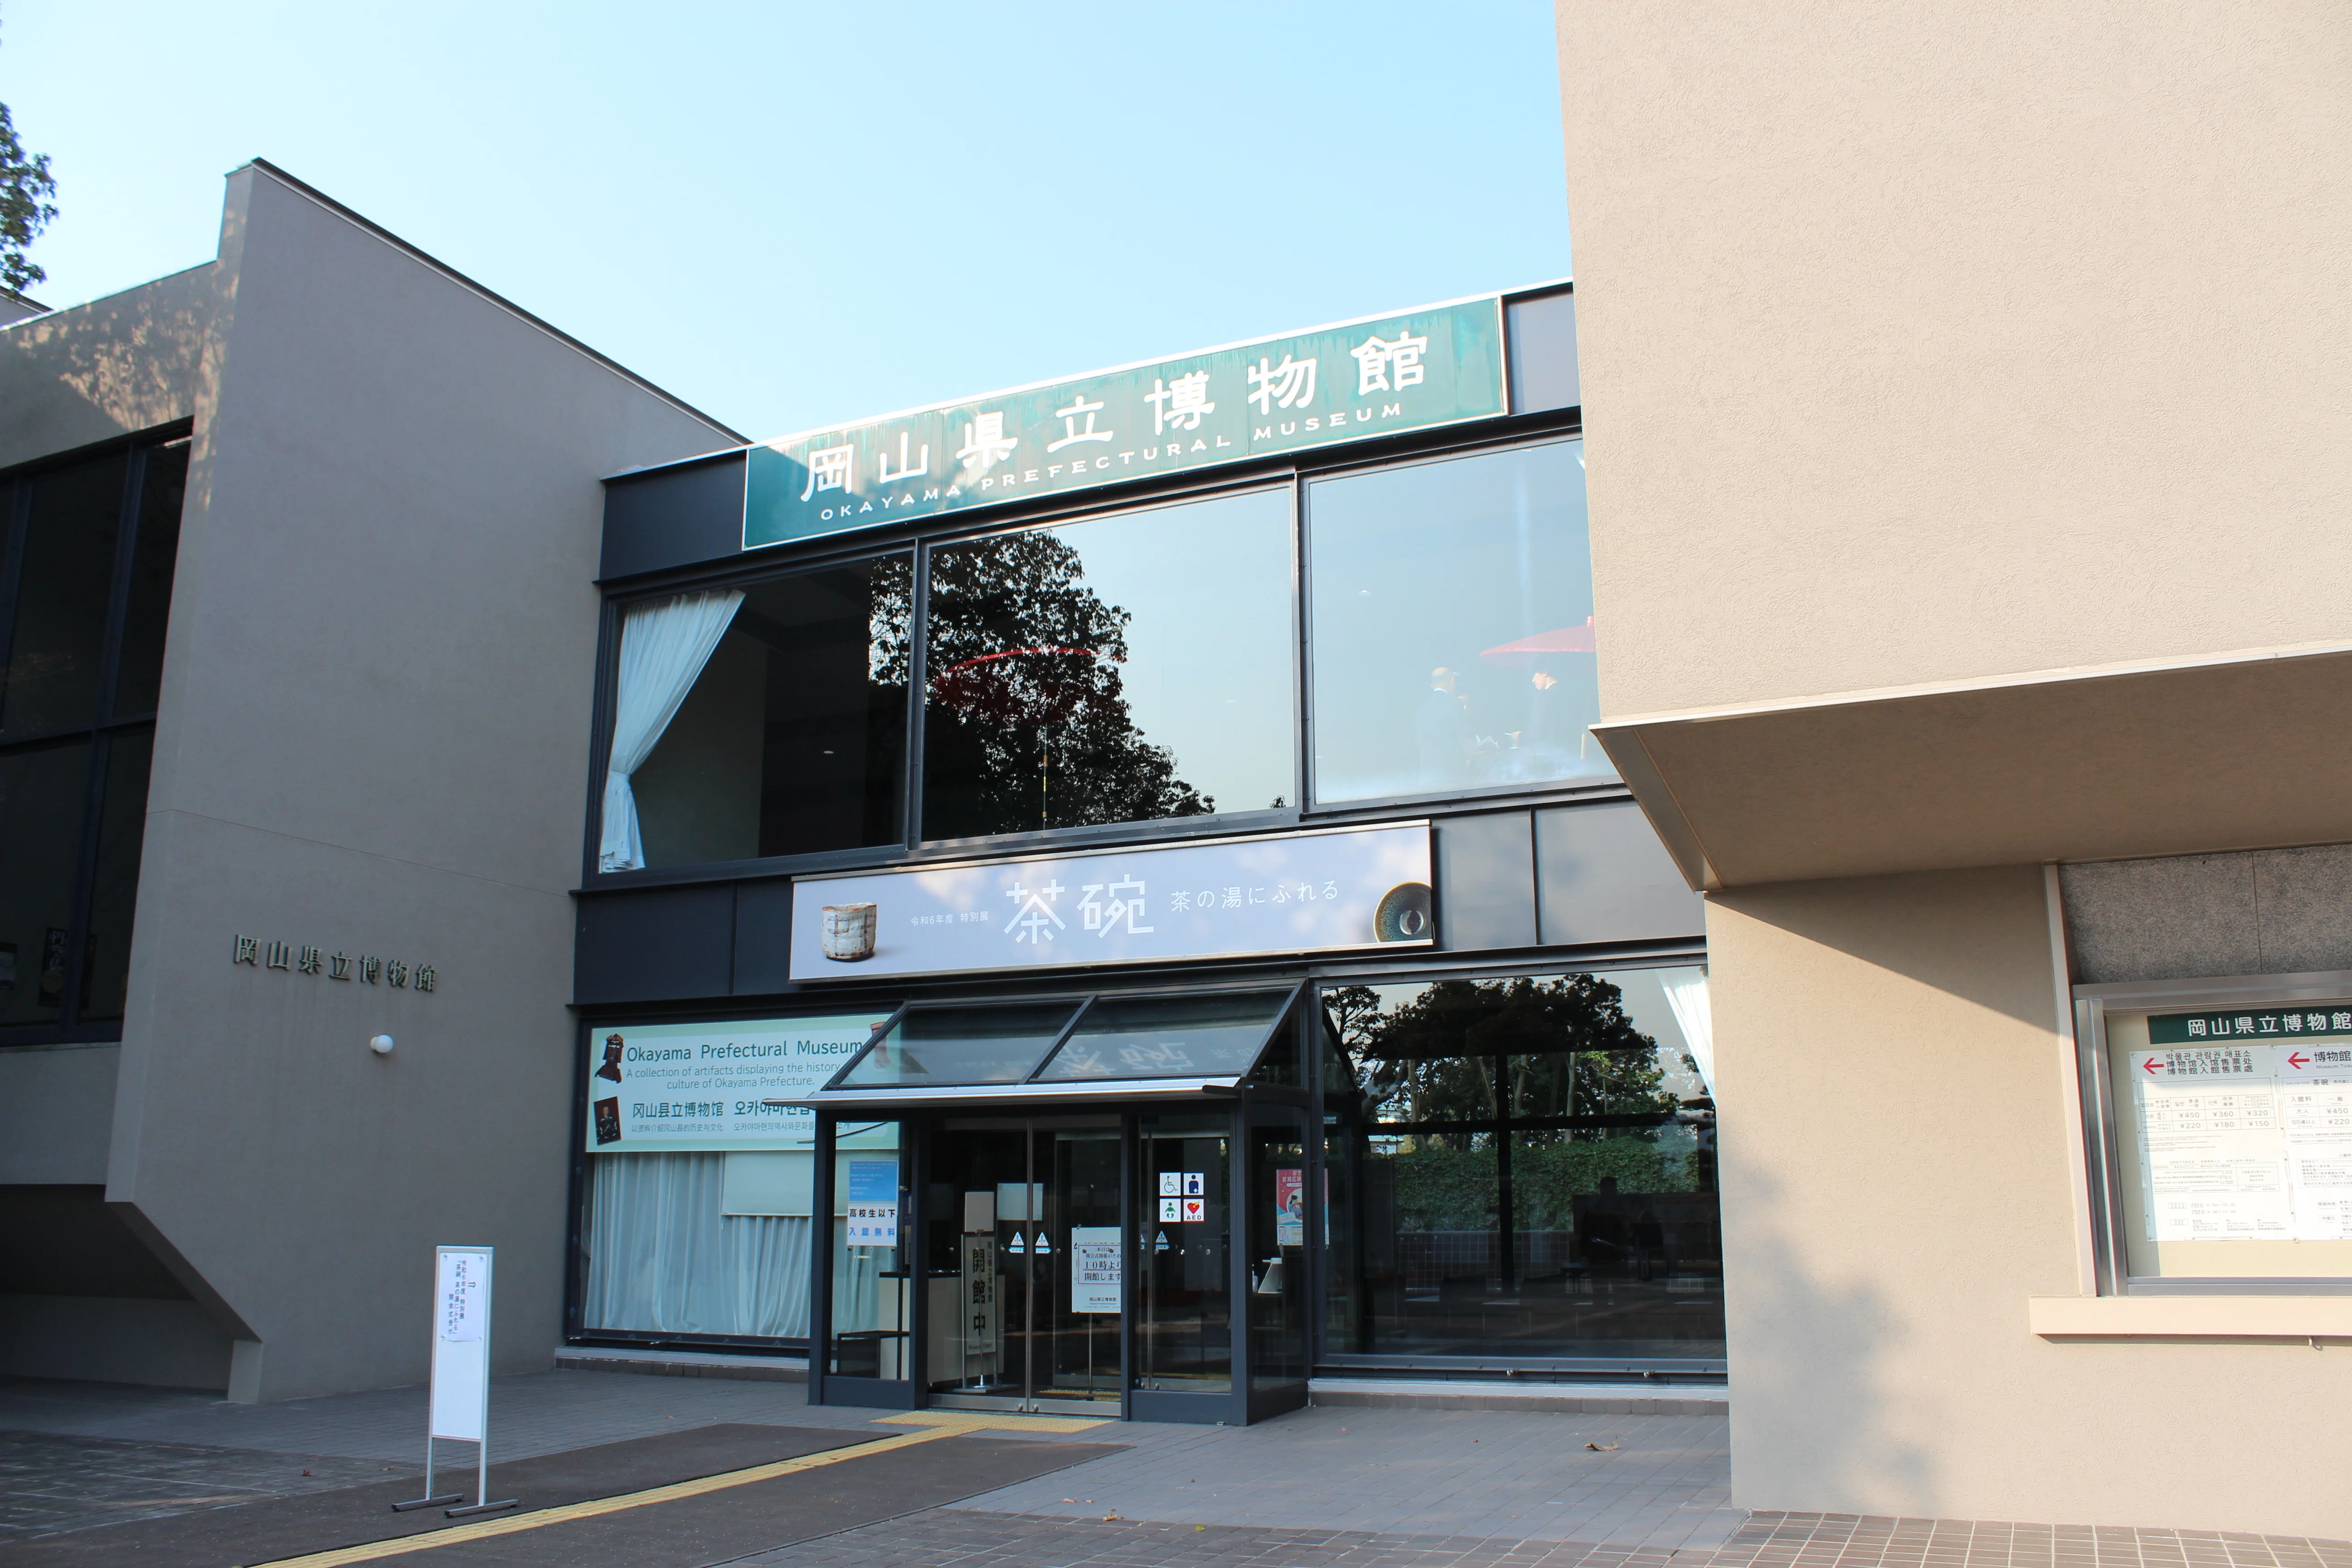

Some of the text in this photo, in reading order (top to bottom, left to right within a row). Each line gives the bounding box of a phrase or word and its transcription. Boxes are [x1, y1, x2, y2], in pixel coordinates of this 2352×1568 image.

[800, 332, 1428, 503] 岡山県立博物館
[820, 402, 1402, 521] OKAYAMA PREFECTURAL MUSEUM
[1171, 878, 1338, 913] 茶の湯にふれる
[1004, 872, 1154, 945] 茶碗
[910, 910, 989, 927] 令和6年度 特別展
[233, 934, 437, 992] 岡山県立博物館
[2187, 1011, 2352, 1037] 岡山県立博物館
[627, 1040, 862, 1062] Okayama Prefectural Museum
[2166, 1050, 2251, 1060] 박물관 관람권 매표소
[2314, 1050, 2352, 1062] 博物館
[627, 1062, 840, 1078] A collection of artifacts displaying the history
[667, 1075, 815, 1089] culture of Okayama Prefecture.
[633, 1101, 724, 1118] 冈山县立博物馆
[849, 1209, 896, 1218] 高校生以下
[849, 1227, 895, 1237] 入館無料
[973, 1249, 986, 1337] 開館中
